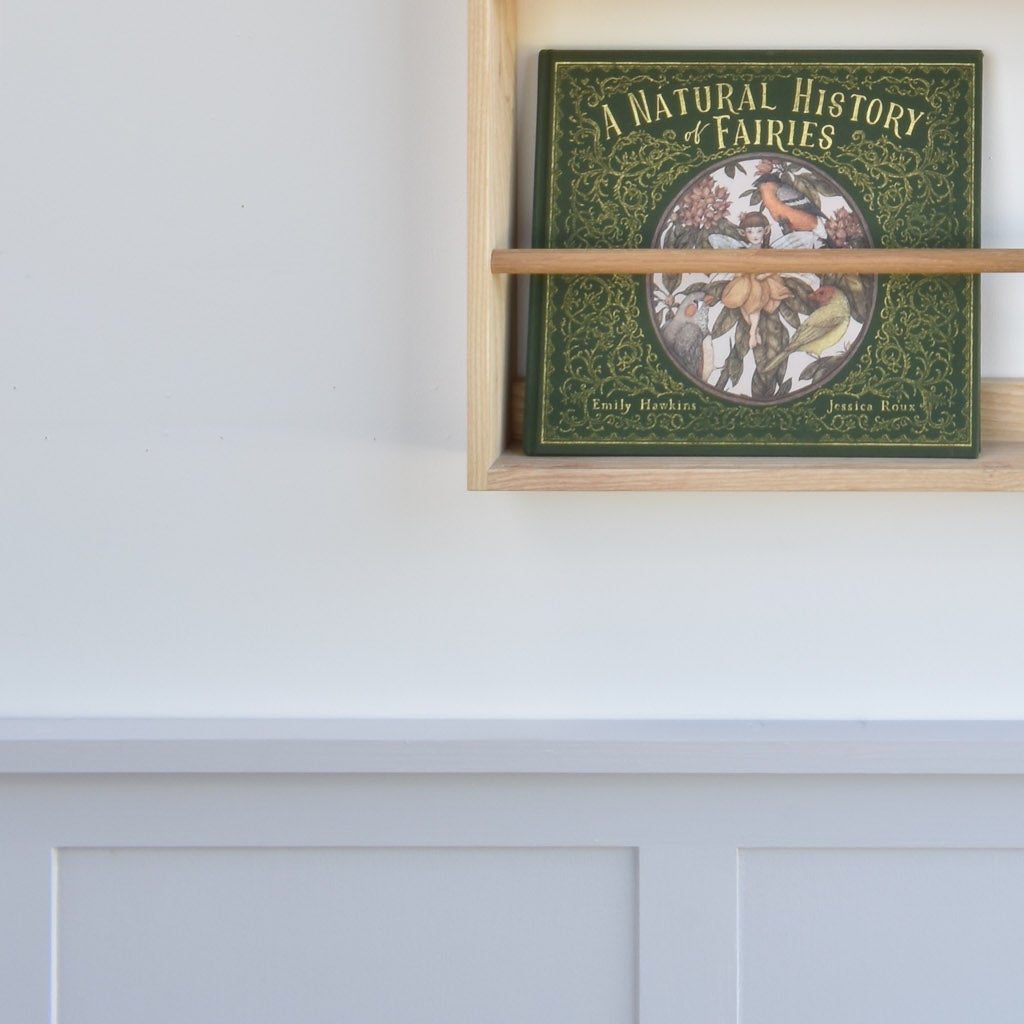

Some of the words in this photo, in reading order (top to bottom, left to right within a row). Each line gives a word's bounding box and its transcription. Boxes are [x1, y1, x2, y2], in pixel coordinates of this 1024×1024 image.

[602, 104, 623, 140] A
[627, 82, 777, 126] NATURAL
[792, 77, 925, 140] HISTORY
[684, 120, 711, 144] of
[712, 114, 836, 153] FAIRIES
[592, 398, 632, 415] Emily
[640, 398, 697, 411] Hawkins
[826, 399, 873, 414] Jessica
[881, 400, 916, 412] Roux
